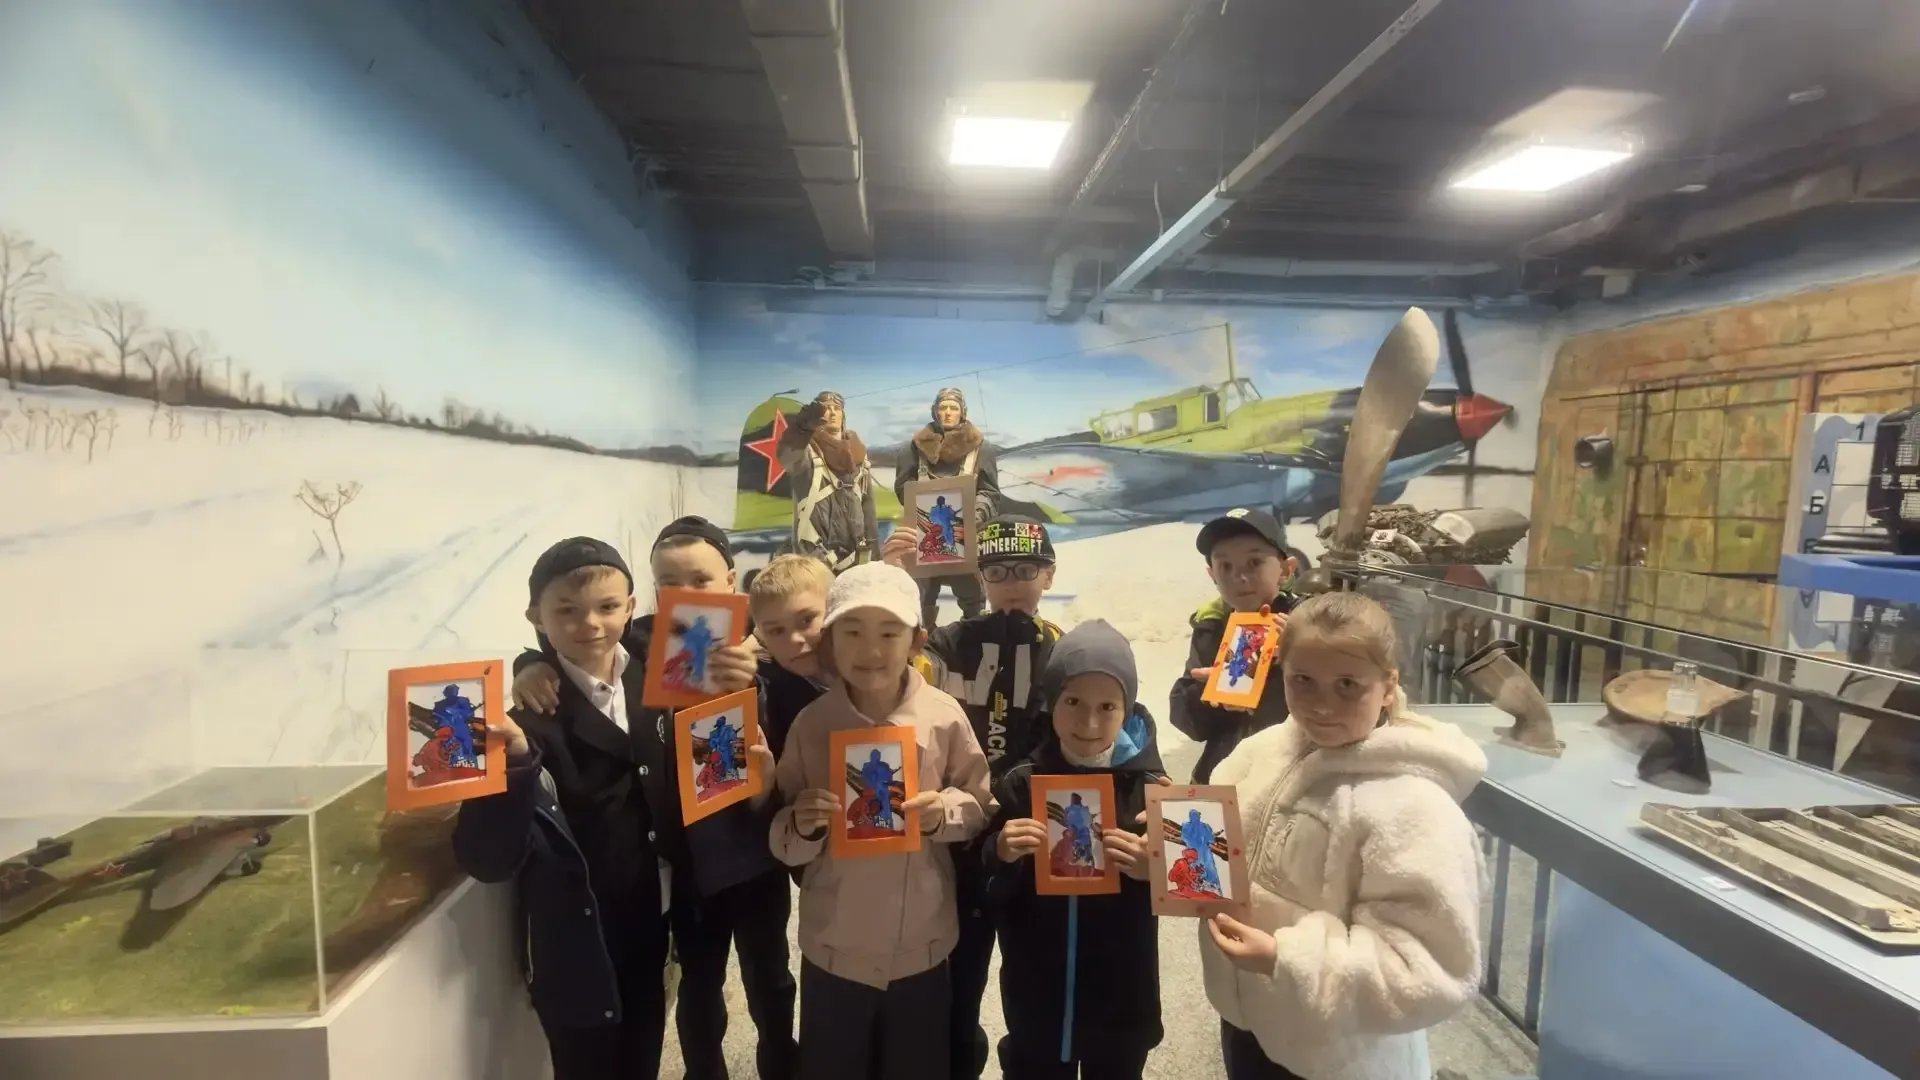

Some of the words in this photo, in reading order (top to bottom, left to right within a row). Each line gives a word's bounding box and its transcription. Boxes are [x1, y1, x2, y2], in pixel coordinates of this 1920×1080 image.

[1856, 421, 1865, 441] 1
[1809, 496, 1824, 515] Б
[977, 537, 1043, 557] MINECRAFT
[988, 698, 1007, 763] LACK
